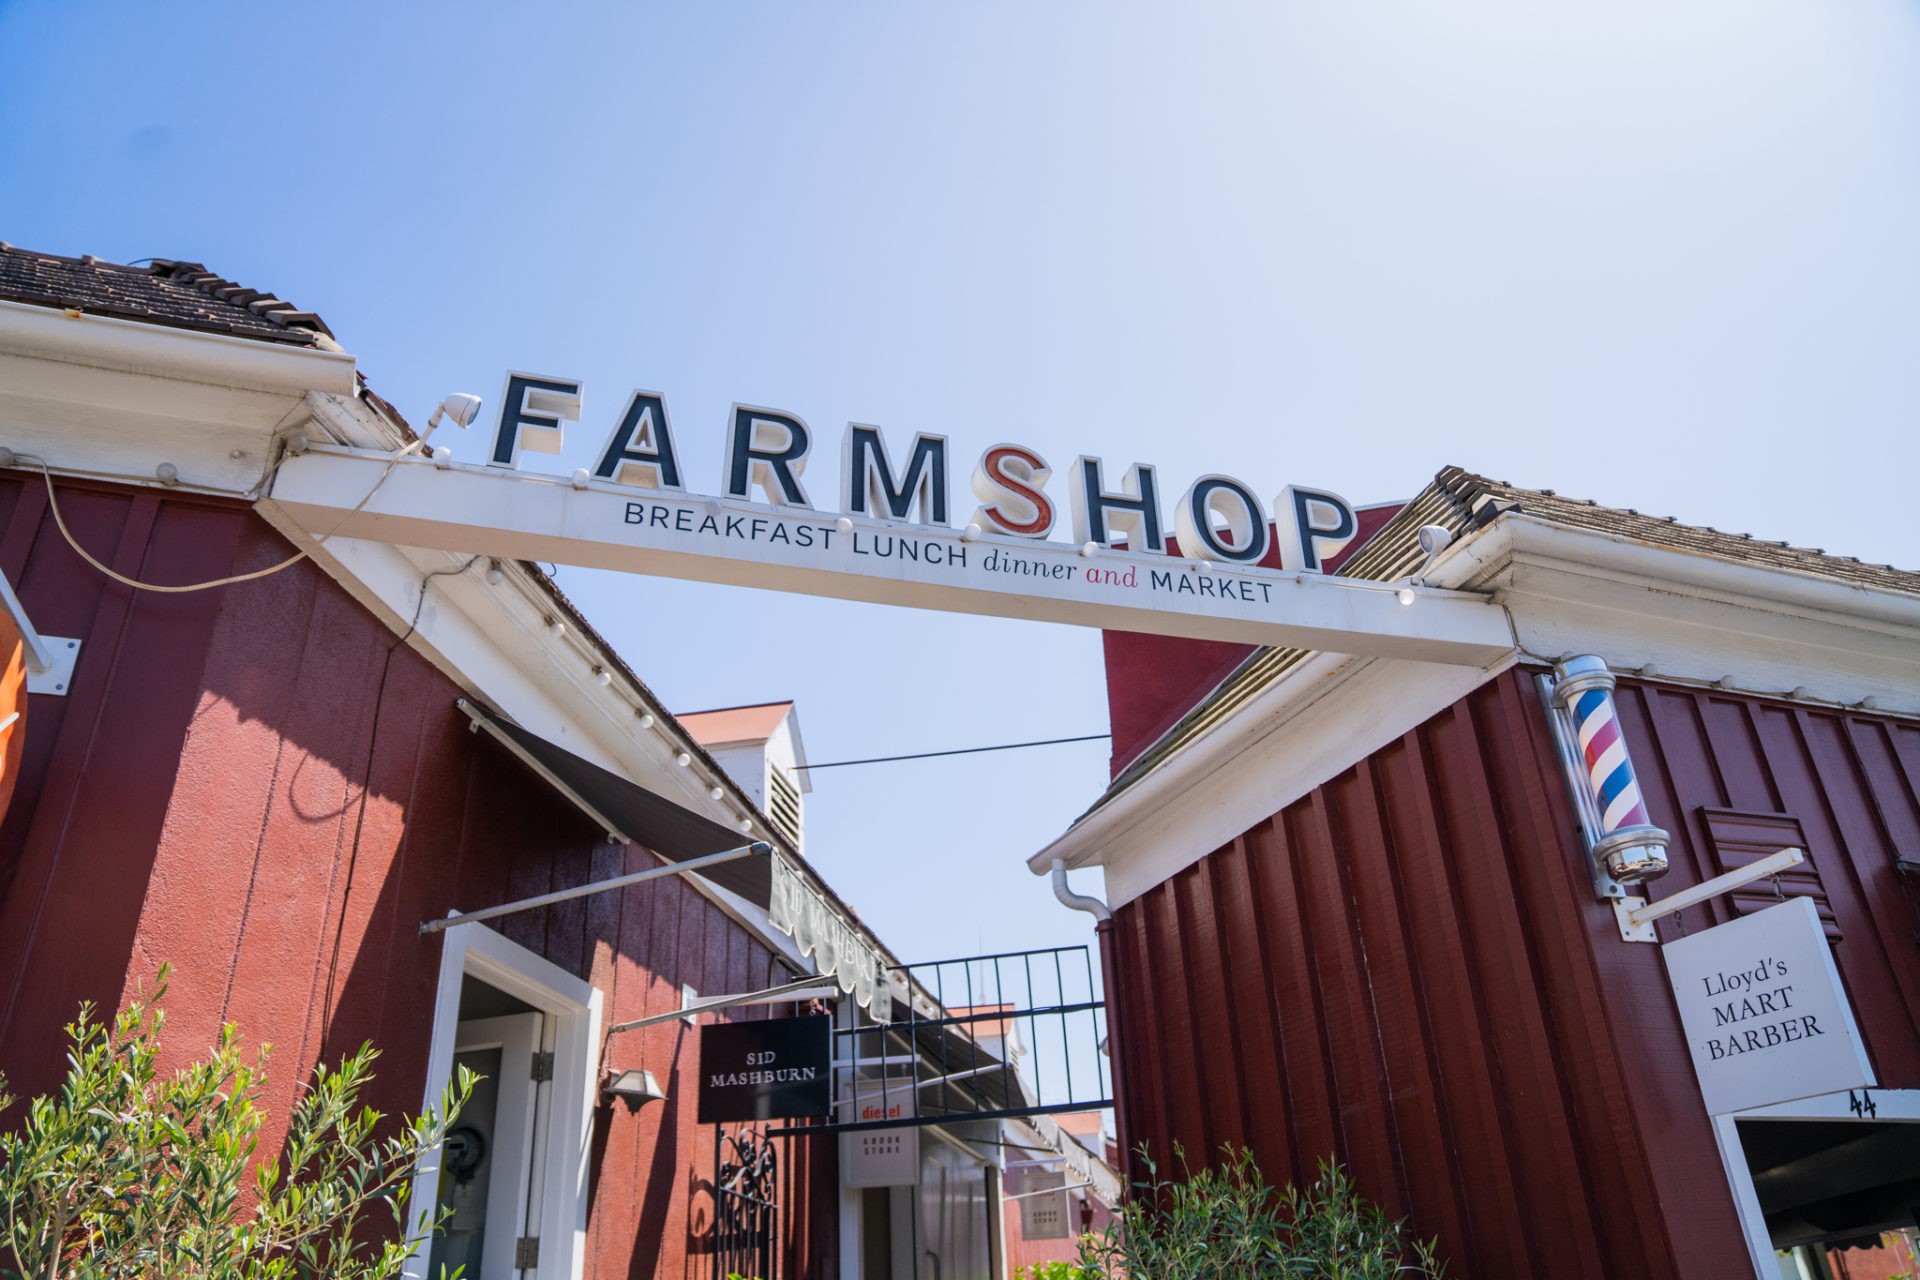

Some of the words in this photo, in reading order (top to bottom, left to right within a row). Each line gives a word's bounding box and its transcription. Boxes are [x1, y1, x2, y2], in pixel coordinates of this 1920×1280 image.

[487, 369, 1358, 573] FARMSHOP
[623, 502, 837, 551] BREAKFAST
[852, 532, 967, 568] LUNCH
[983, 548, 1078, 580] dinner
[1085, 565, 1139, 588] and
[1150, 570, 1273, 604] MARKET
[1701, 957, 1788, 998] Lloyd's
[1712, 985, 1794, 1027] MART
[746, 1051, 776, 1066] SID
[1705, 1015, 1825, 1061] BARBER
[709, 1066, 816, 1088] MASHBURN
[1849, 1089, 1877, 1120] 44
